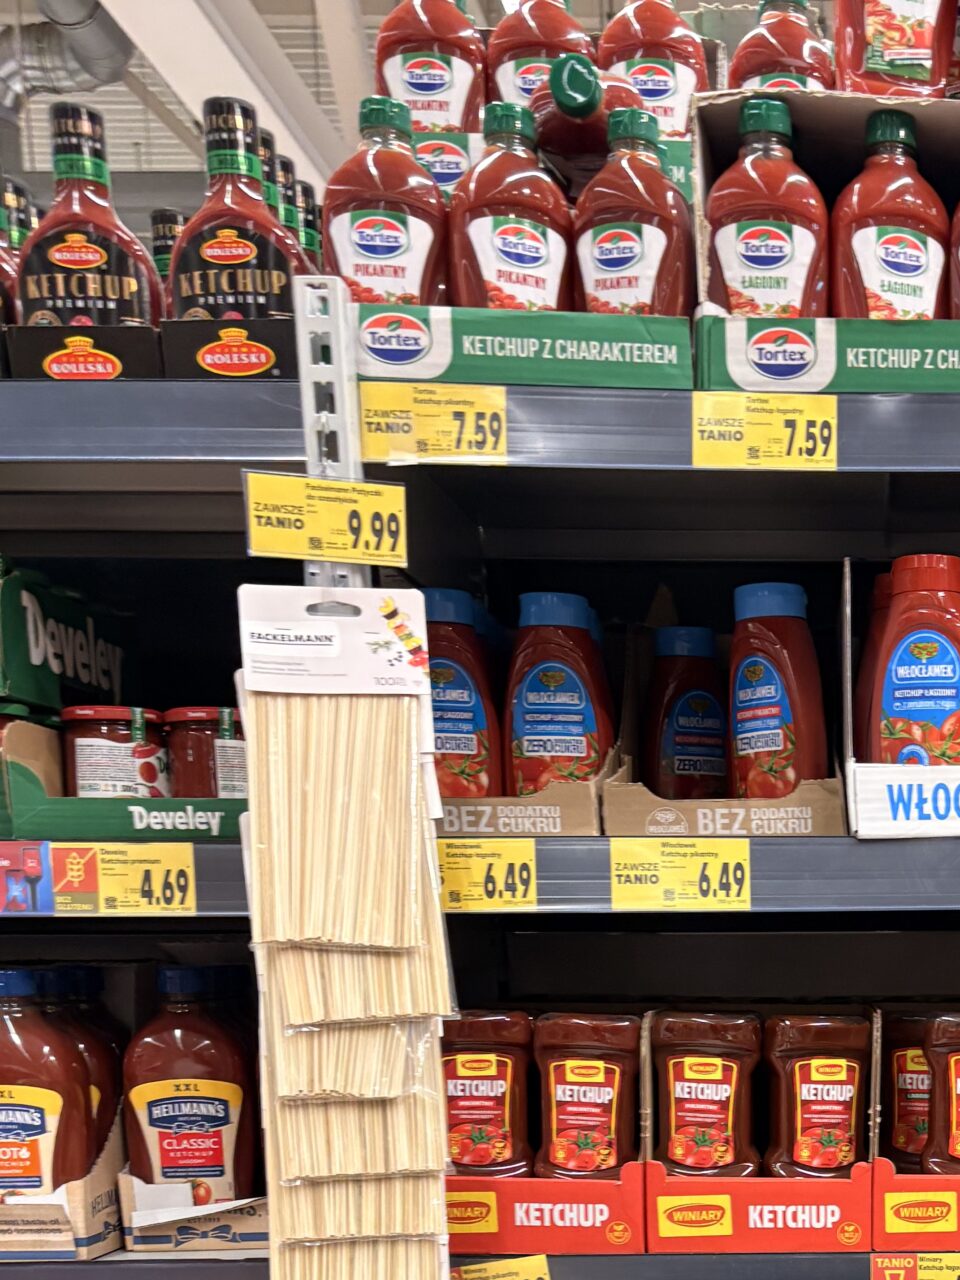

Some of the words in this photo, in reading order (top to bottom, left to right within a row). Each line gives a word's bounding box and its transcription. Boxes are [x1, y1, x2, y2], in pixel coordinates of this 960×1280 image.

[356, 232, 401, 246] Tortex
[598, 245, 637, 257] Tortex
[743, 241, 785, 256] Tortex
[882, 248, 921, 264] Tortex
[462, 334, 537, 358] KETCHUP
[542, 339, 552, 359] Z
[555, 339, 678, 365] CHARAKTEREM
[755, 346, 807, 362] Tortex
[846, 347, 921, 369] KETCHUP
[924, 349, 934, 369] Z
[364, 409, 412, 420] ZAWSZE
[697, 417, 744, 428] ZAWSZE
[365, 421, 413, 435] TANIO
[452, 410, 502, 451] 7.59
[698, 429, 744, 442] TANIO
[783, 418, 832, 458] 7.59
[253, 501, 305, 516] ZAWSZE
[348, 509, 400, 552] 9.99
[249, 631, 335, 645] FACKELMANN
[128, 805, 224, 836] Develey
[443, 805, 495, 833] BEZ
[499, 805, 561, 818] DODATKU
[500, 818, 562, 833] CUKRU
[696, 807, 747, 835] BEZ
[750, 807, 813, 820] DODATKU
[750, 819, 813, 834] CUKRU
[140, 868, 190, 906] 4.69
[483, 862, 532, 899] 6.49
[698, 861, 746, 898] 6.49
[152, 1099, 226, 1119] HELLMANN'S
[162, 1136, 219, 1151] CLASSIC
[513, 1203, 609, 1227] KETCHUP
[672, 1209, 723, 1223] WINIARY
[748, 1204, 841, 1229] KETCHUP
[899, 1205, 949, 1218] WINIARY
[875, 1257, 914, 1268] TANIO
